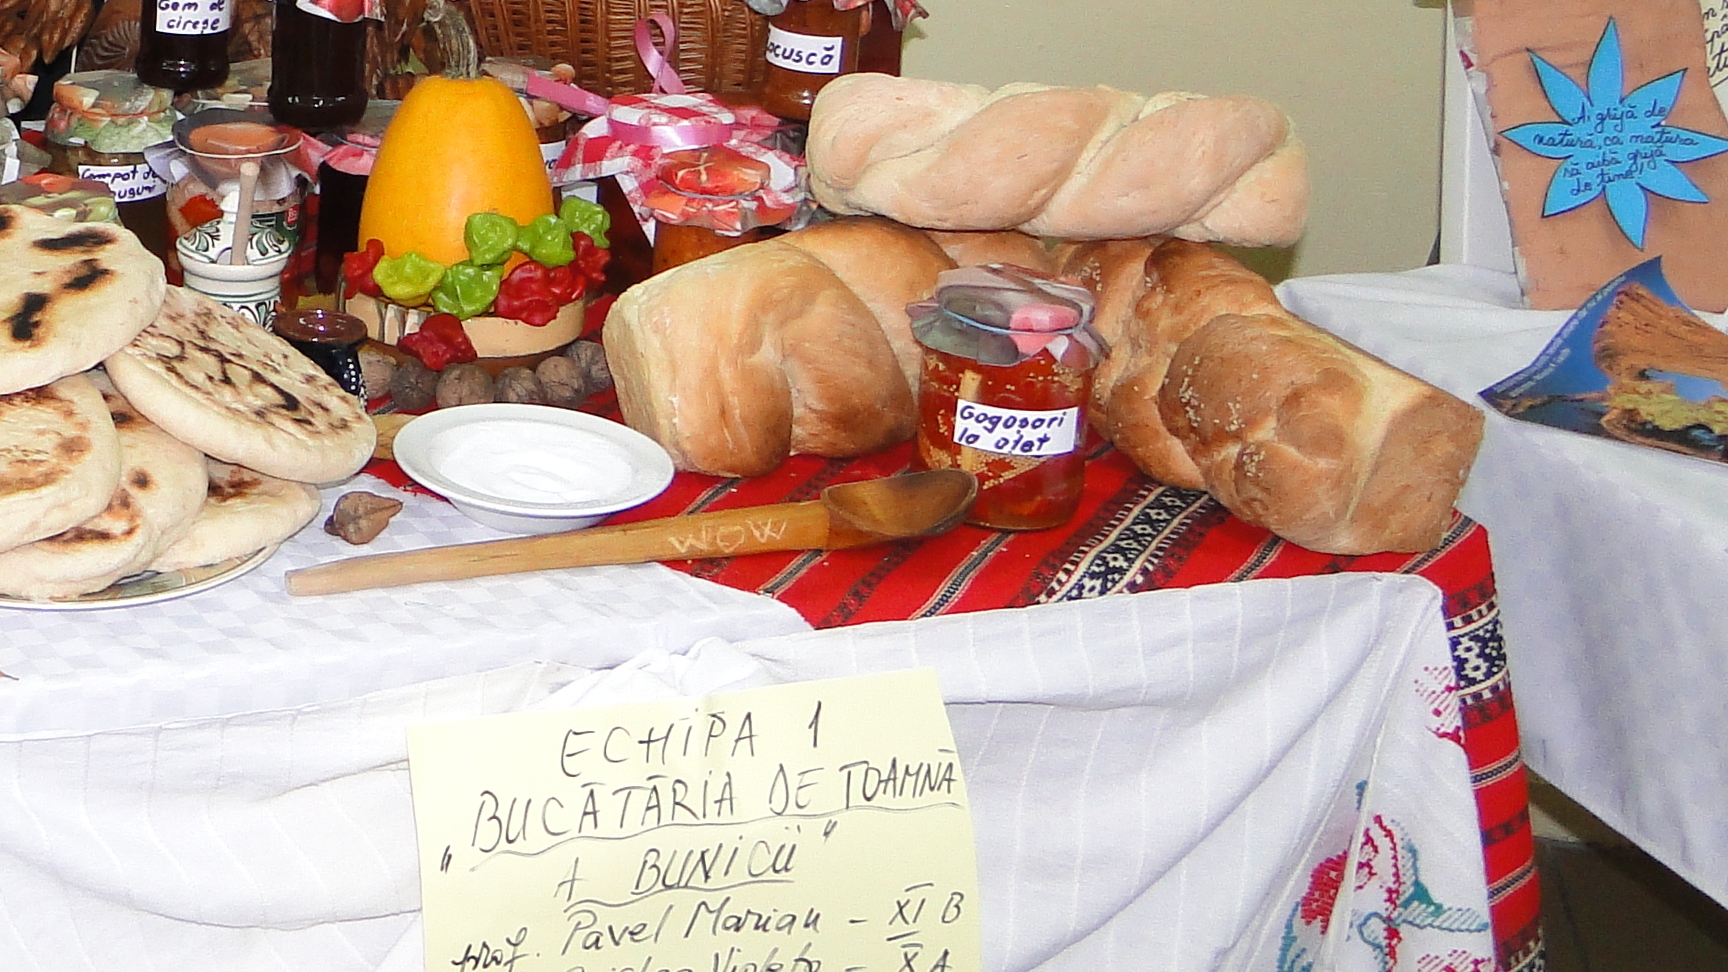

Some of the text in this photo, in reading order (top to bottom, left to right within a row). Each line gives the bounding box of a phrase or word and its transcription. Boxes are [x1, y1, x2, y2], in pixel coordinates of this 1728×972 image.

[1643, 99, 1667, 119] de
[958, 427, 981, 445] la
[560, 700, 822, 778] ECHIPA 1
[768, 762, 825, 816] DE
[561, 903, 674, 956] Pavel
[683, 895, 822, 940] Marian
[940, 891, 965, 925] B
